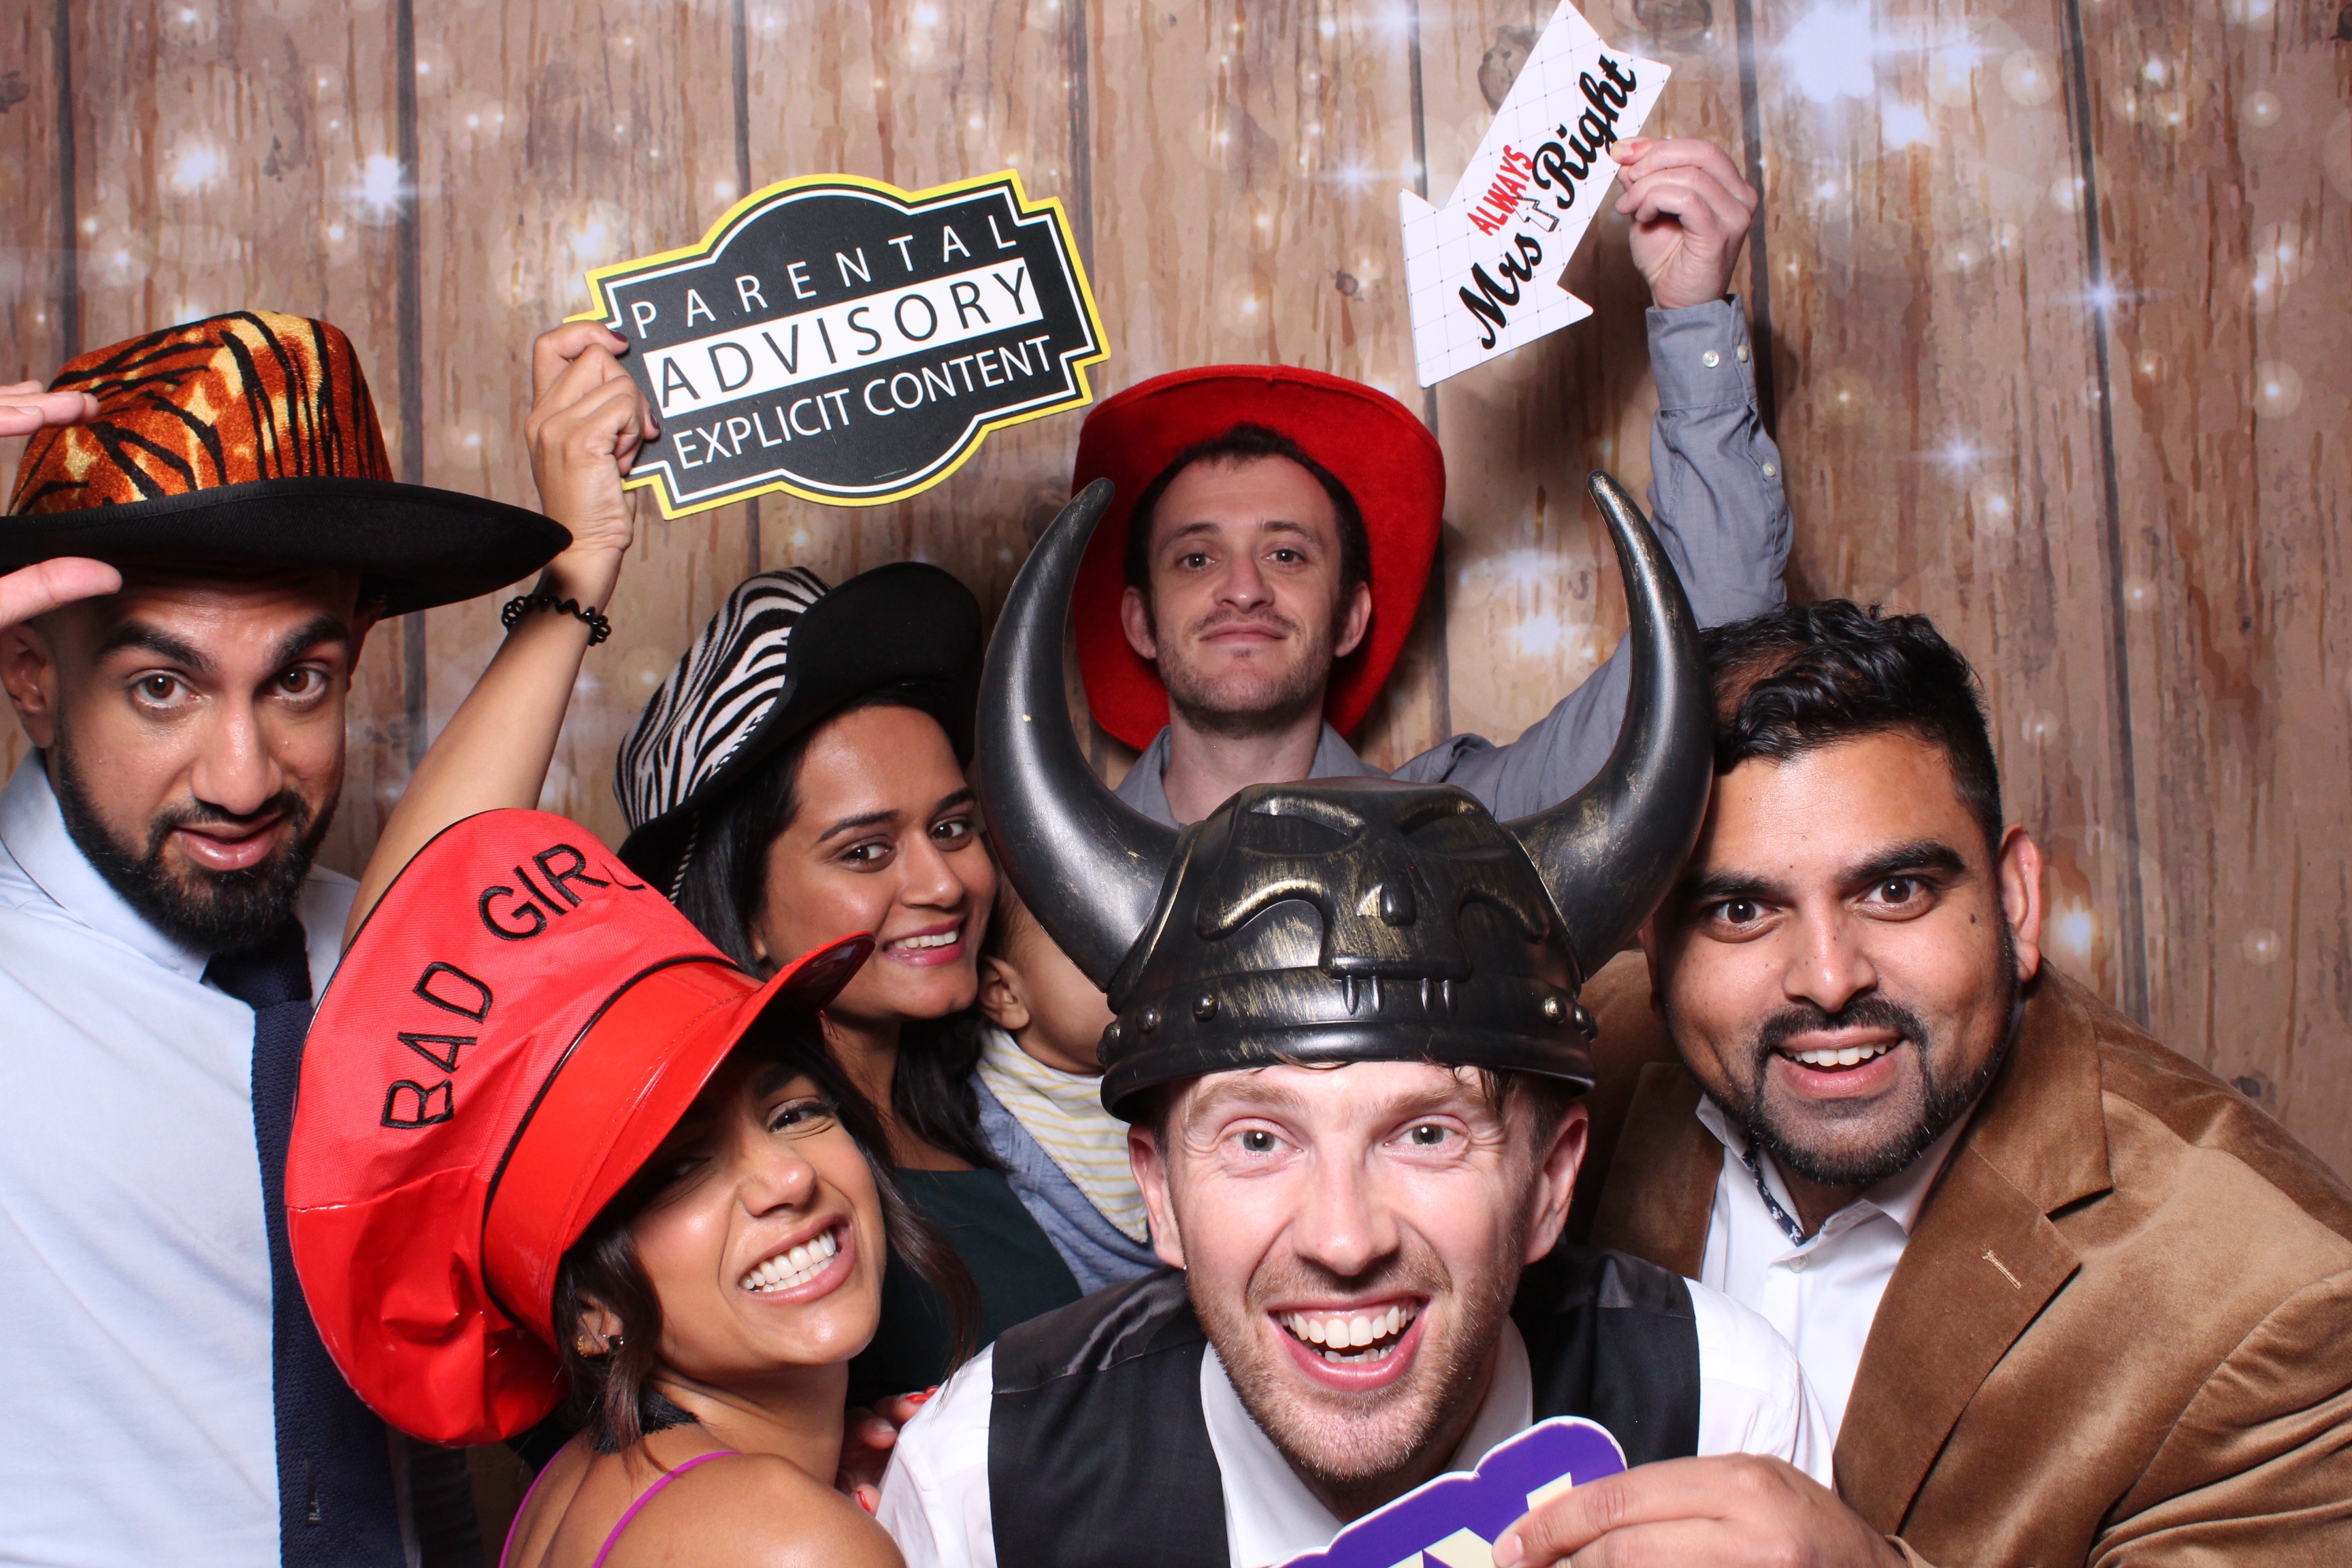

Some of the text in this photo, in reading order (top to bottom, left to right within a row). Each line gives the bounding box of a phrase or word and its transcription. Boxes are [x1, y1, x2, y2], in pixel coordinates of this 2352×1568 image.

[1458, 54, 1637, 350] Mrs Right
[1467, 145, 1533, 236] ALWAYS
[630, 214, 1017, 339] PARENTAL
[662, 266, 1026, 408] ADVISORY
[672, 335, 1051, 470] EXPLICIT CONTENT
[380, 962, 493, 1129] BAD
